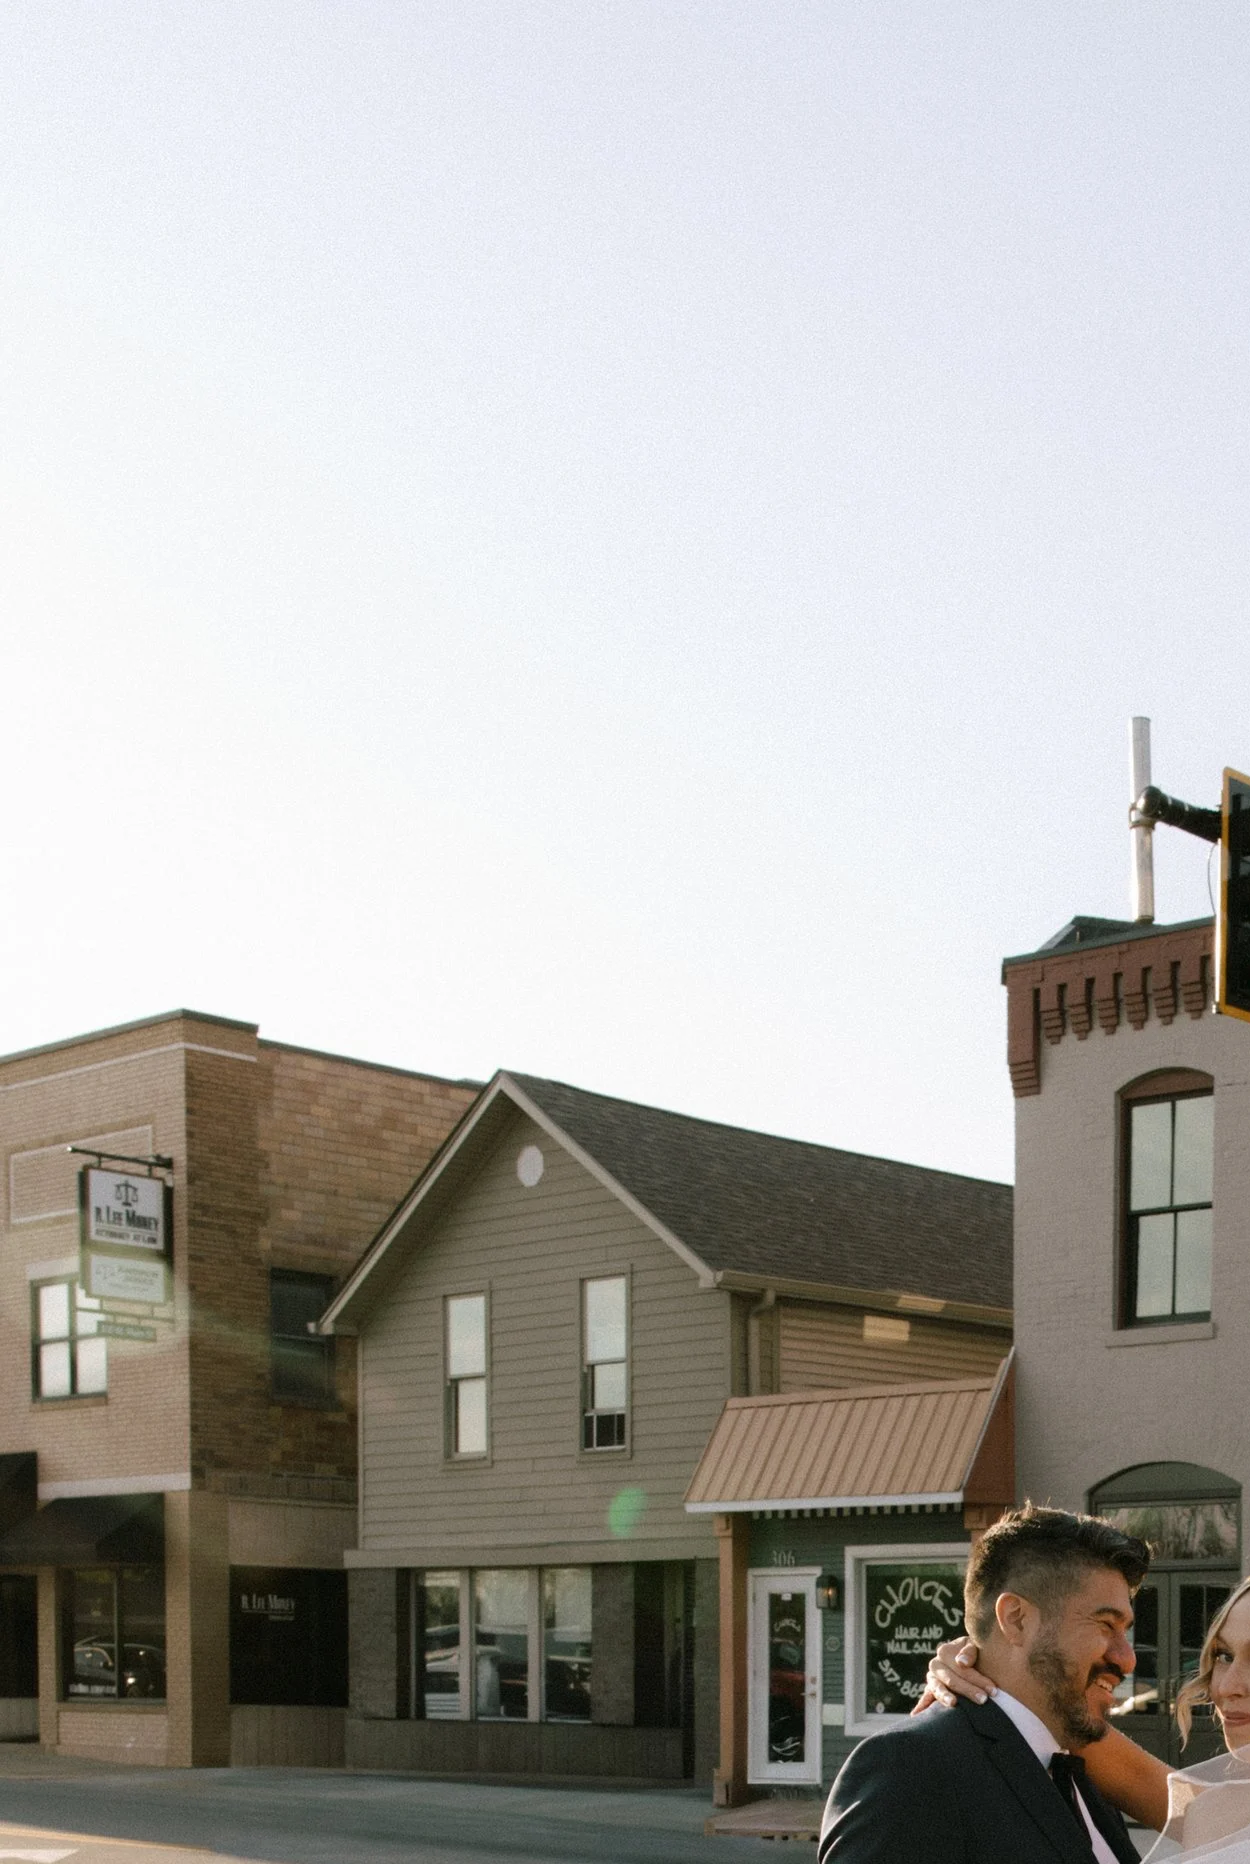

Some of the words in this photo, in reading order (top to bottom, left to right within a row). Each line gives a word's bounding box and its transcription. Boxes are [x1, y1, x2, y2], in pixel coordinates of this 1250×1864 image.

[772, 1550, 795, 1567] 306
[921, 1623, 943, 1640] AND
[886, 1640, 911, 1654] NAIL
